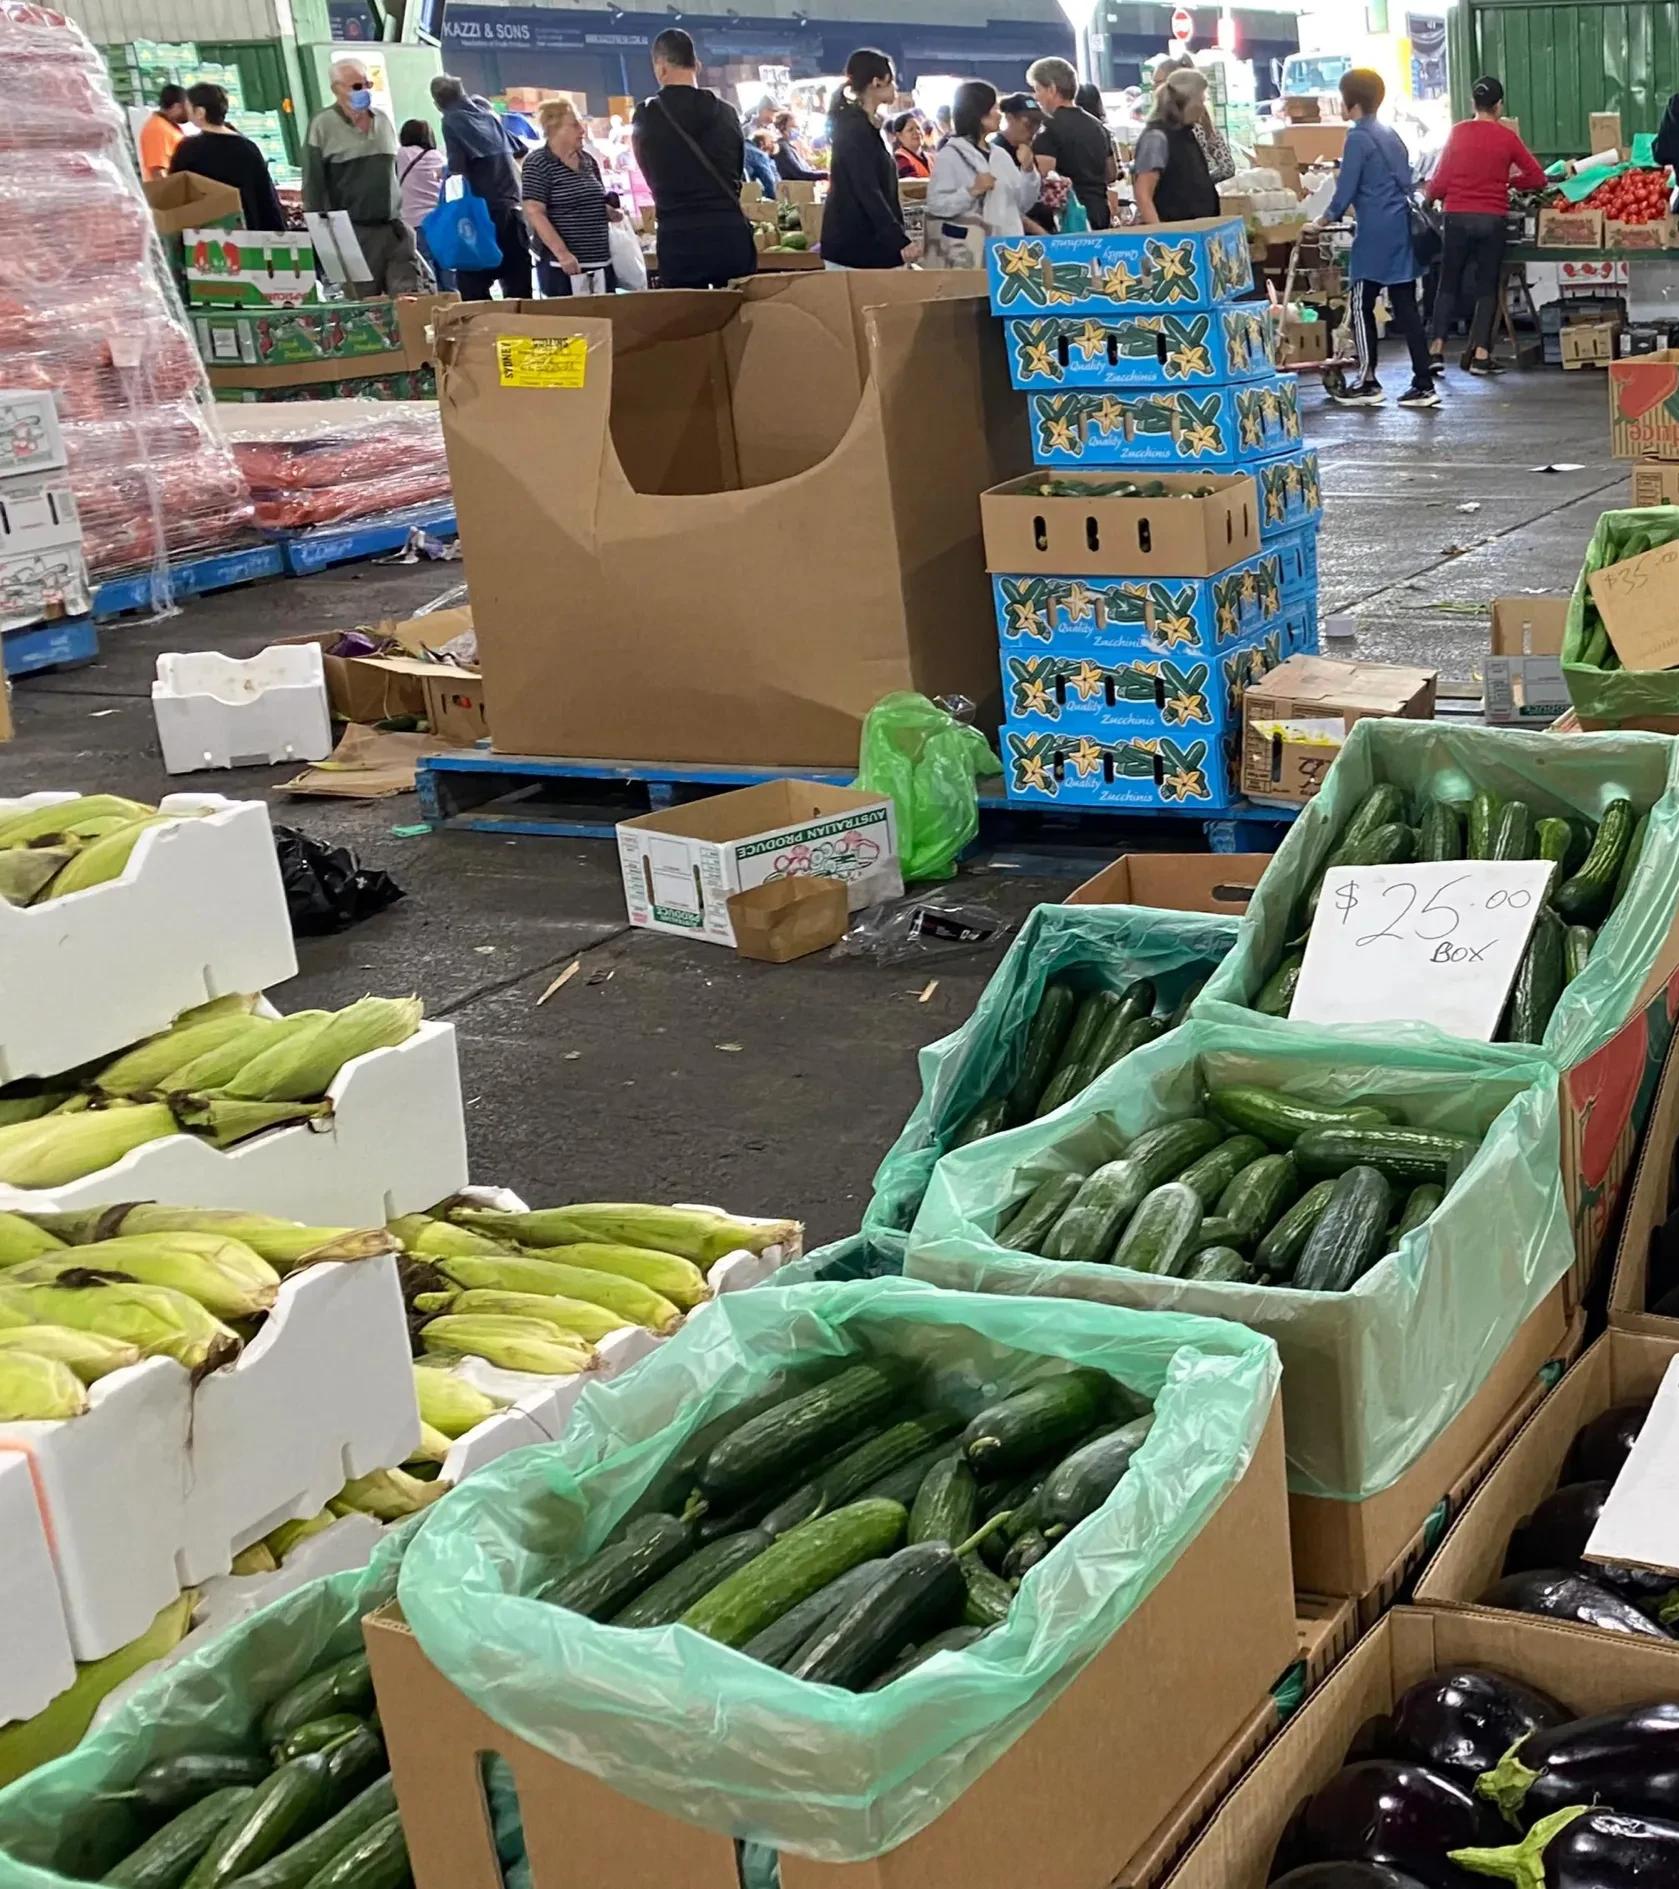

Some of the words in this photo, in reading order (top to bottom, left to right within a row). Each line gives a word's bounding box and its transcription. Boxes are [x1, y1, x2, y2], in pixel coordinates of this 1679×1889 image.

[496, 24, 530, 39] SONS
[1051, 236, 1104, 250] Zucchinis
[501, 342, 514, 379] SYDNEY
[1069, 360, 1106, 376] Quality
[1104, 369, 1158, 383] Zucchinis
[1088, 435, 1123, 450] Quality
[1120, 446, 1172, 459] Zucchinis
[1058, 622, 1095, 637] Quality
[1066, 700, 1104, 715] Quality
[1101, 712, 1155, 726] Zucchinis
[1064, 777, 1102, 792] Quality
[1099, 789, 1154, 802] Zucchinis
[806, 809, 887, 840] AUSTRALIAN
[737, 832, 804, 859] PRODUCE
[1430, 938, 1500, 963] BOX
